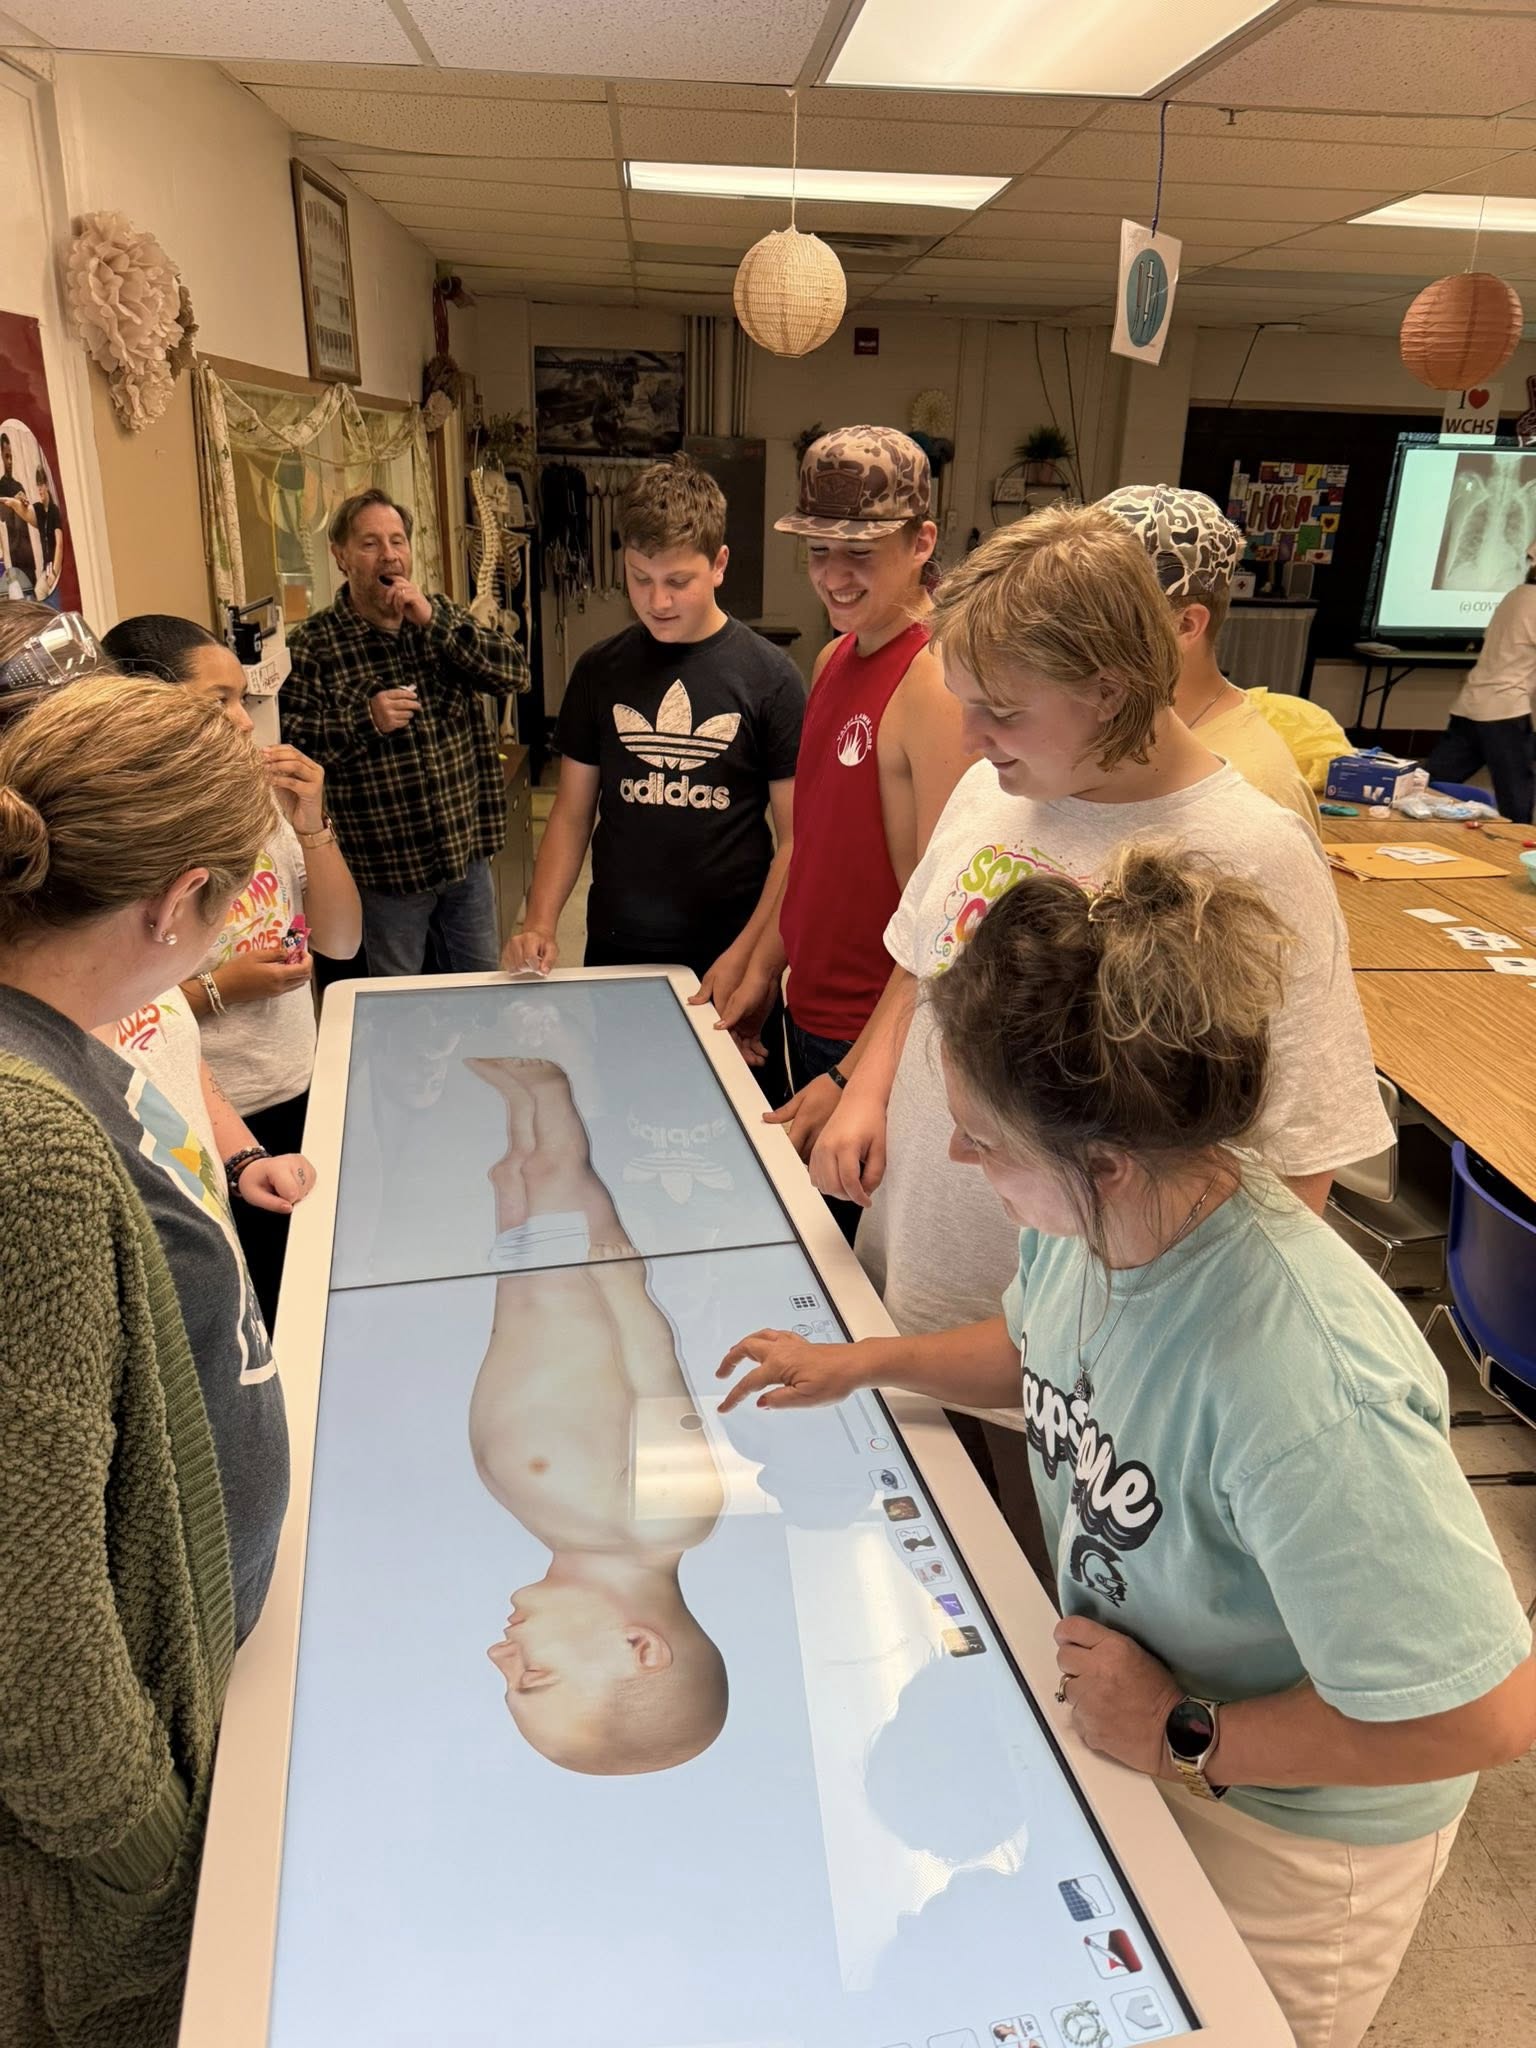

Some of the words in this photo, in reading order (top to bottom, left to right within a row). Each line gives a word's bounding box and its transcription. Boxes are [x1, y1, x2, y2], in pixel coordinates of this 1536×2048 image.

[1457, 390, 1467, 409] I
[1445, 419, 1495, 434] WCHS
[1248, 491, 1312, 532] HOSA
[620, 772, 731, 811] adidas
